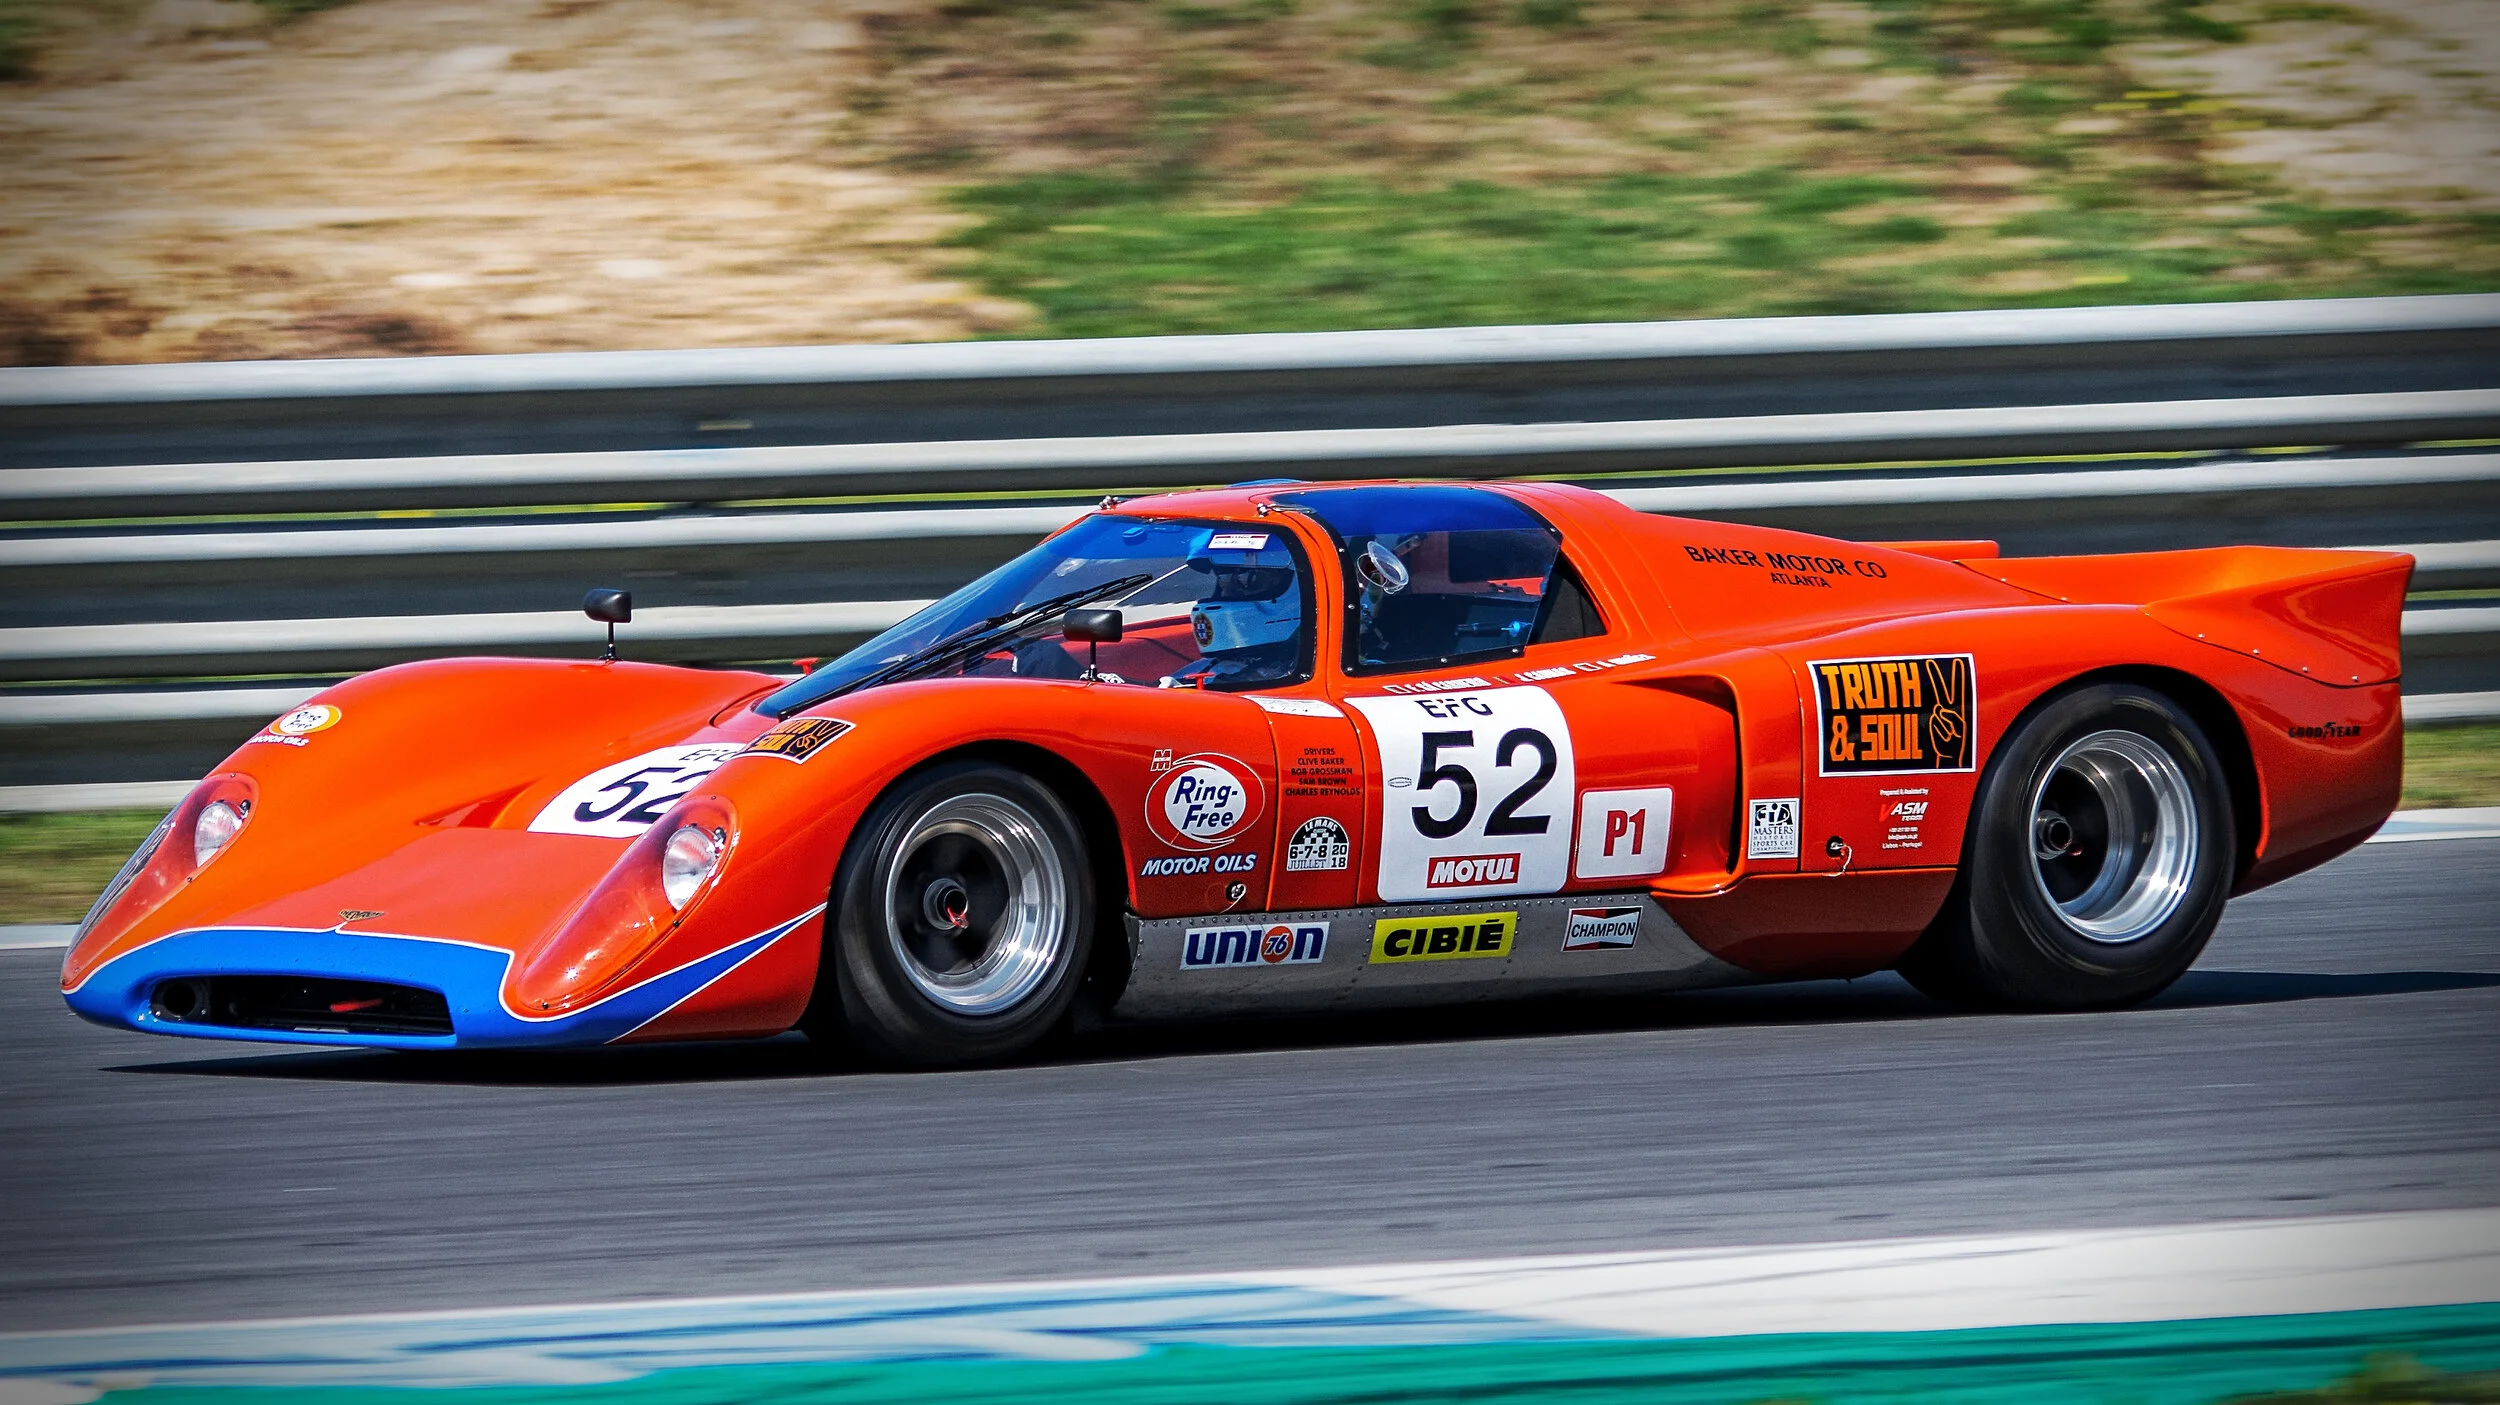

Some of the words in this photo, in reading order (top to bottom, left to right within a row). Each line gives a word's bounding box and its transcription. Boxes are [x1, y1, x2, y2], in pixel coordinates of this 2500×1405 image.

[1684, 545, 1764, 568] BAKER
[1765, 552, 1852, 576] MOTOR
[1854, 560, 1887, 579] CO
[1771, 572, 1832, 588] ATLANTA
[1820, 662, 1922, 709] TRUTH
[1415, 697, 1493, 718] EFG
[1830, 715, 1855, 761] &
[1860, 713, 1923, 761] SOUL
[1304, 747, 1335, 756] DRIVERS
[1297, 758, 1318, 766] CLIVE
[1320, 757, 1345, 766] BAKER
[1291, 768, 1307, 776] BOB
[1309, 767, 1353, 776] GROSSMAN
[1298, 778, 1315, 786] SAM
[1317, 777, 1347, 786] BROWN
[1411, 728, 1557, 839] 52
[574, 766, 712, 824] 52
[1173, 775, 1238, 808] Ring-
[1285, 788, 1318, 796] CHARLES
[1320, 787, 1361, 796] REYNOLDS
[1890, 801, 1929, 816] ASM
[1182, 804, 1234, 830] Free
[1305, 821, 1314, 832] LE
[1314, 819, 1338, 832] MANS
[1603, 808, 1646, 857] P1
[1754, 826, 1794, 836] MASTERS
[1289, 845, 1327, 859] 6-7-8
[1332, 844, 1348, 855] 20
[1140, 857, 1210, 876] MOTOR
[1213, 853, 1257, 873] OILS
[1288, 860, 1326, 870] JUILLET
[1331, 857, 1346, 868] 18
[1431, 858, 1515, 884] MOTUL
[1571, 922, 1636, 938] CHAMPION
[1264, 933, 1290, 955] 76
